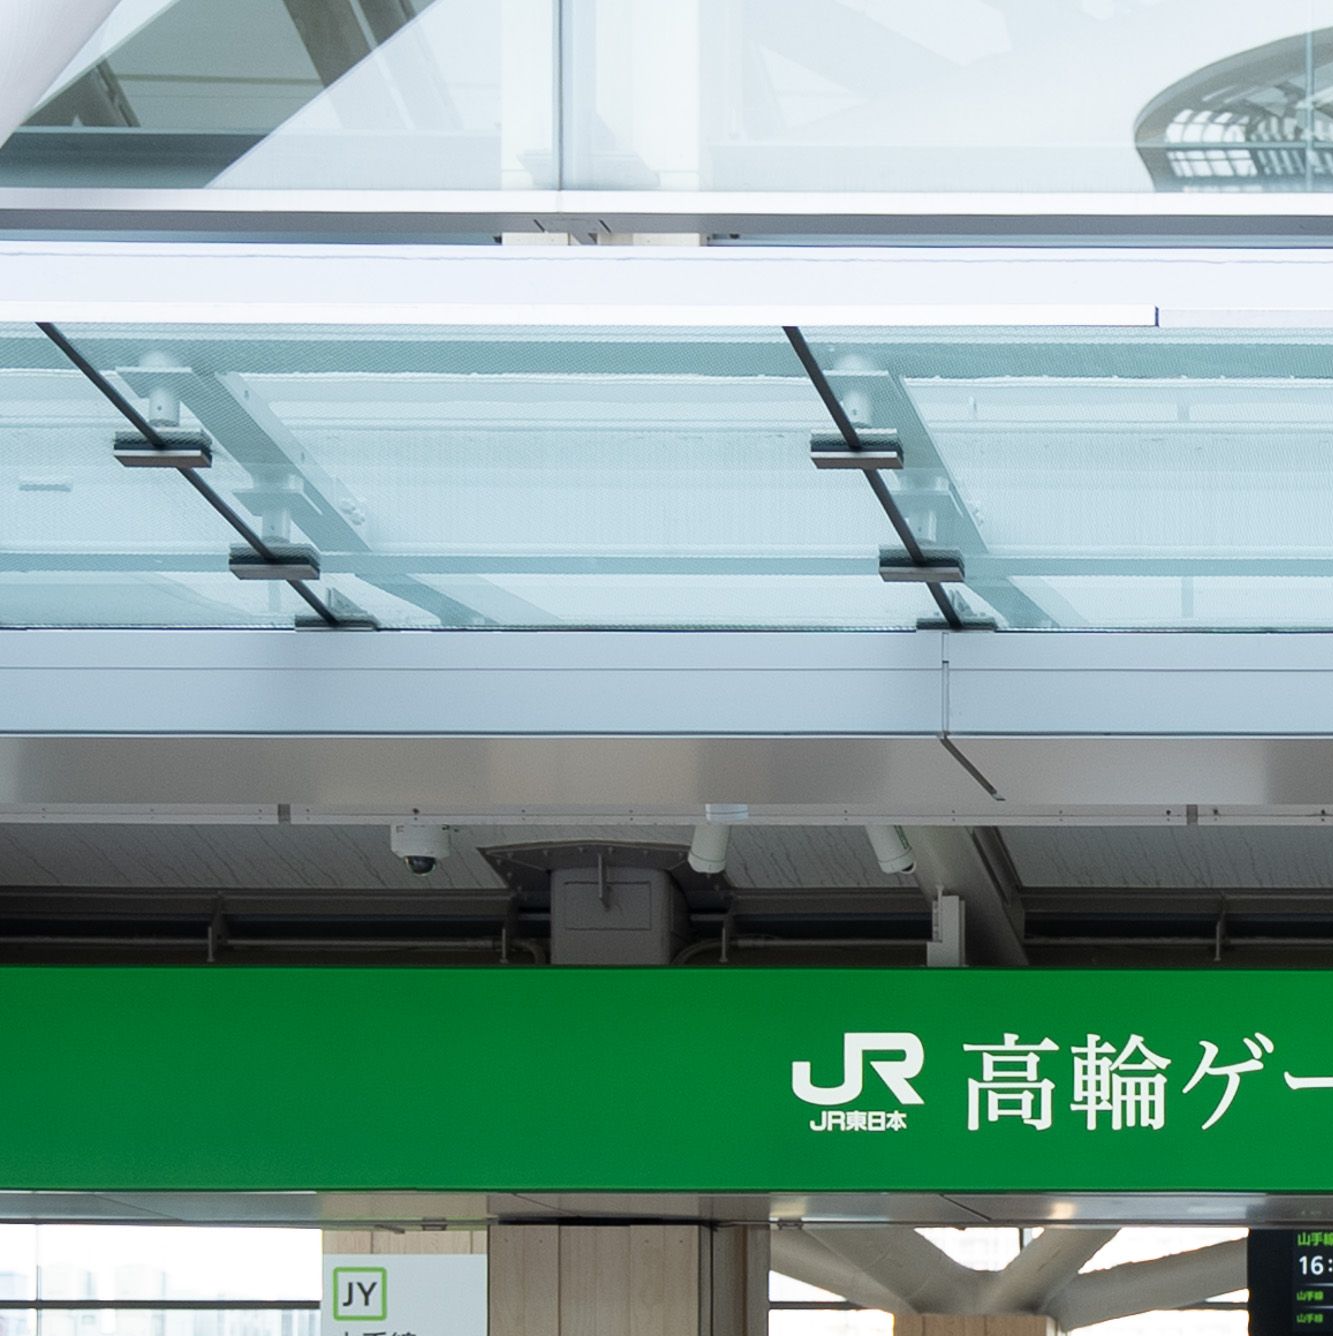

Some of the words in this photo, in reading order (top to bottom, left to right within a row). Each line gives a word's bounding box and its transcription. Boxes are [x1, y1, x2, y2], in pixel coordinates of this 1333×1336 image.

[793, 1033, 924, 1105] JR
[810, 1111, 906, 1131] JR東日本
[342, 1281, 377, 1307] JY
